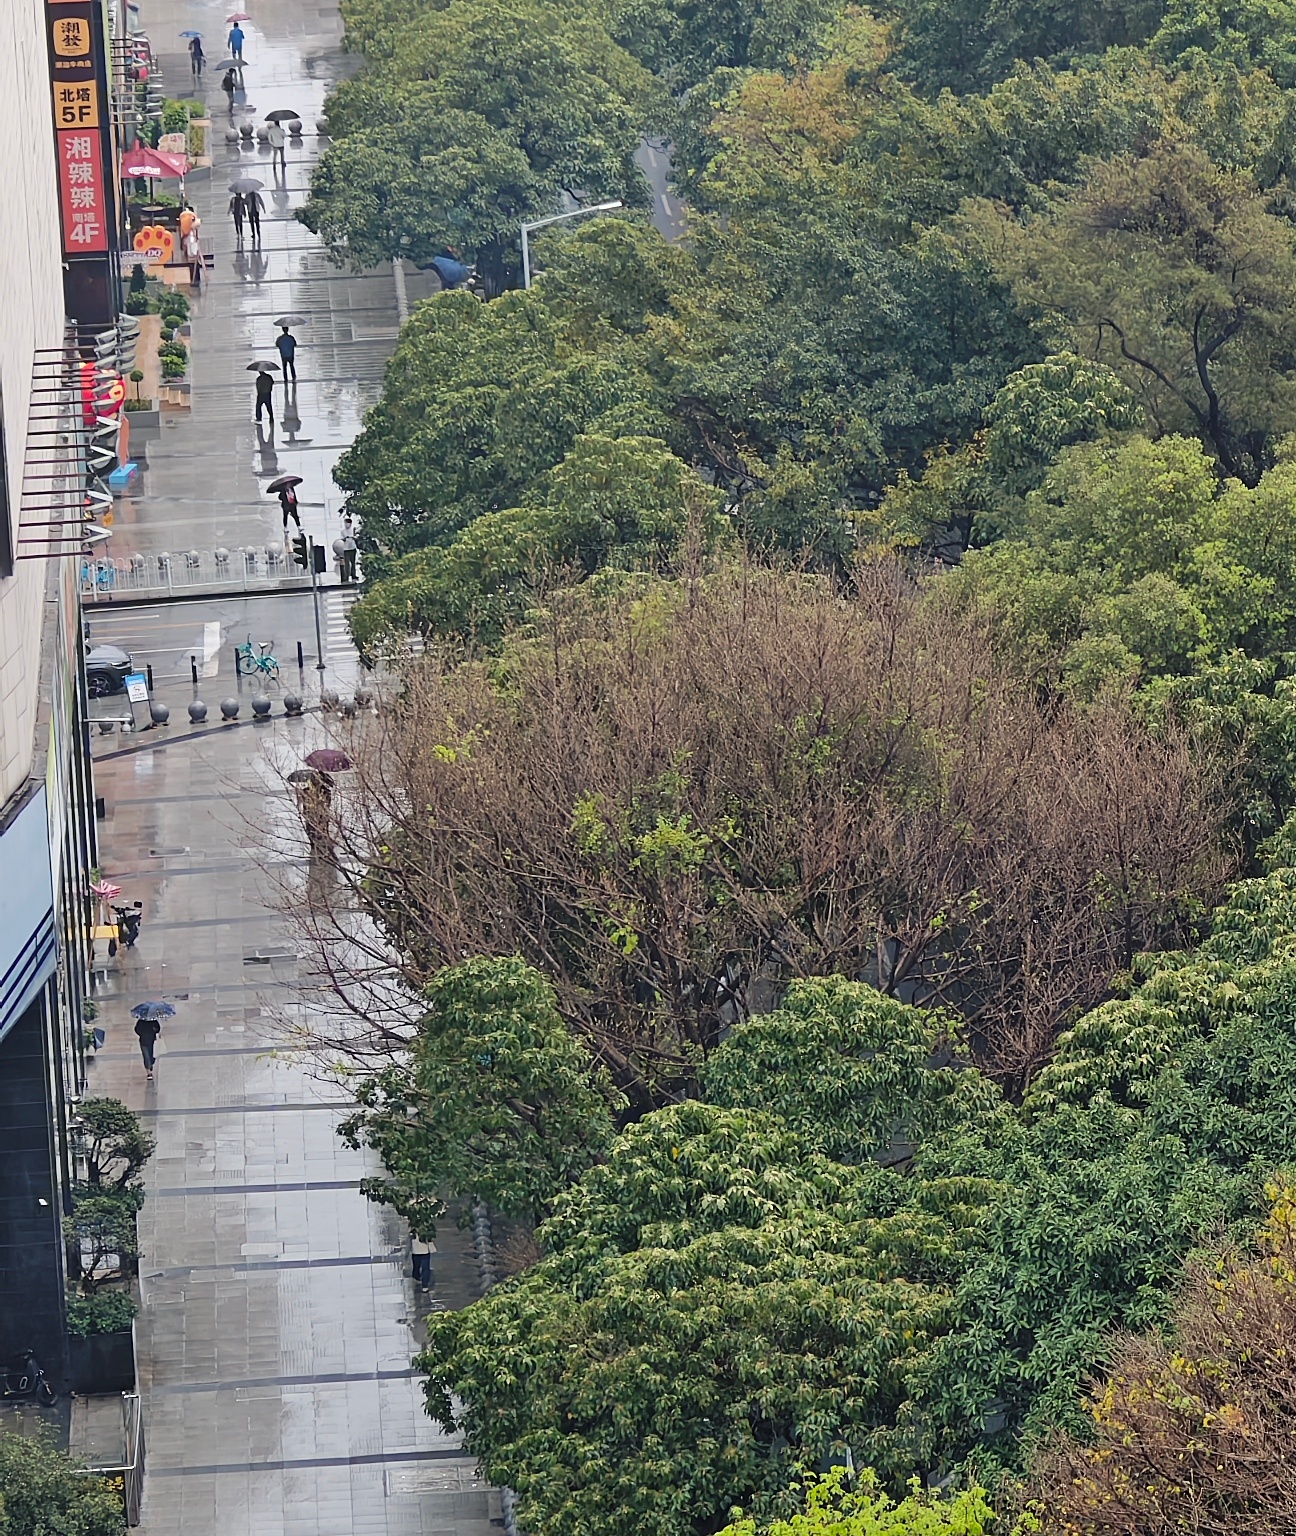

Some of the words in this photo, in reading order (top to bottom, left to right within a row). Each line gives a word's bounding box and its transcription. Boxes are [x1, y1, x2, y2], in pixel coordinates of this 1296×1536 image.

[60, 21, 82, 47] 潮發
[60, 88, 91, 103] 北塔
[62, 105, 91, 123] 5F
[65, 136, 96, 209] 湘辣辣
[69, 223, 100, 244] 4F
[147, 249, 162, 257] DQ
